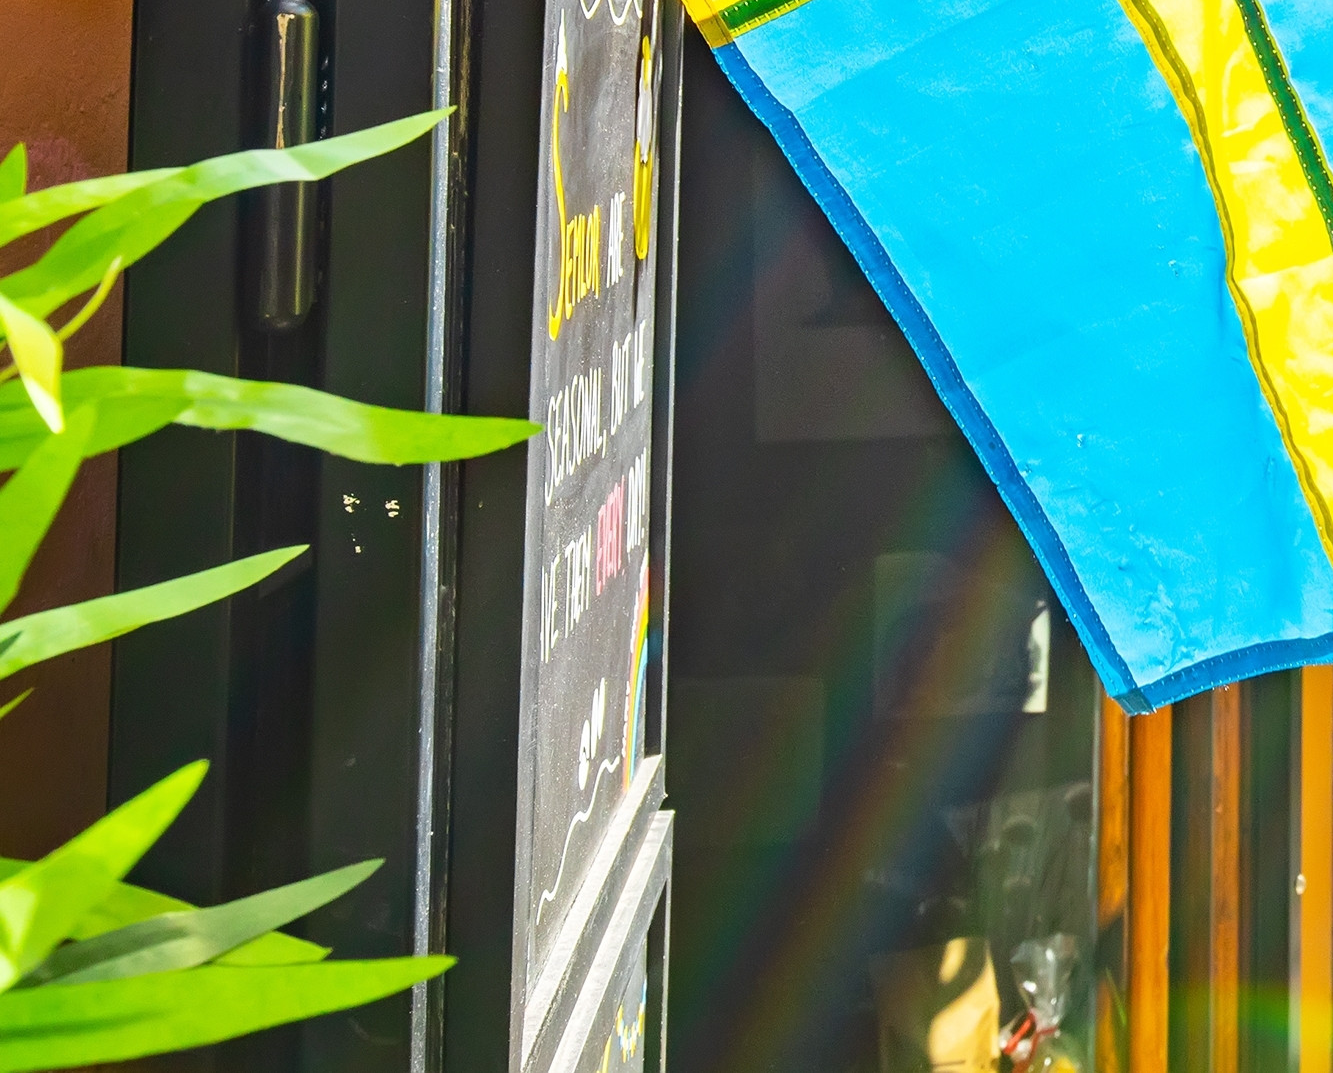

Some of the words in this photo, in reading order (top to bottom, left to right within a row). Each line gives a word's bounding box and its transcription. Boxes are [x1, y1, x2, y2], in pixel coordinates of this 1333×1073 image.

[606, 191, 626, 288] ARE
[545, 367, 607, 505] SEASONAL,
[611, 332, 632, 436] BUT
[633, 319, 646, 408] WE
[564, 525, 592, 639] THEM
[596, 475, 626, 596] EVERY
[627, 447, 647, 555] DAY!
